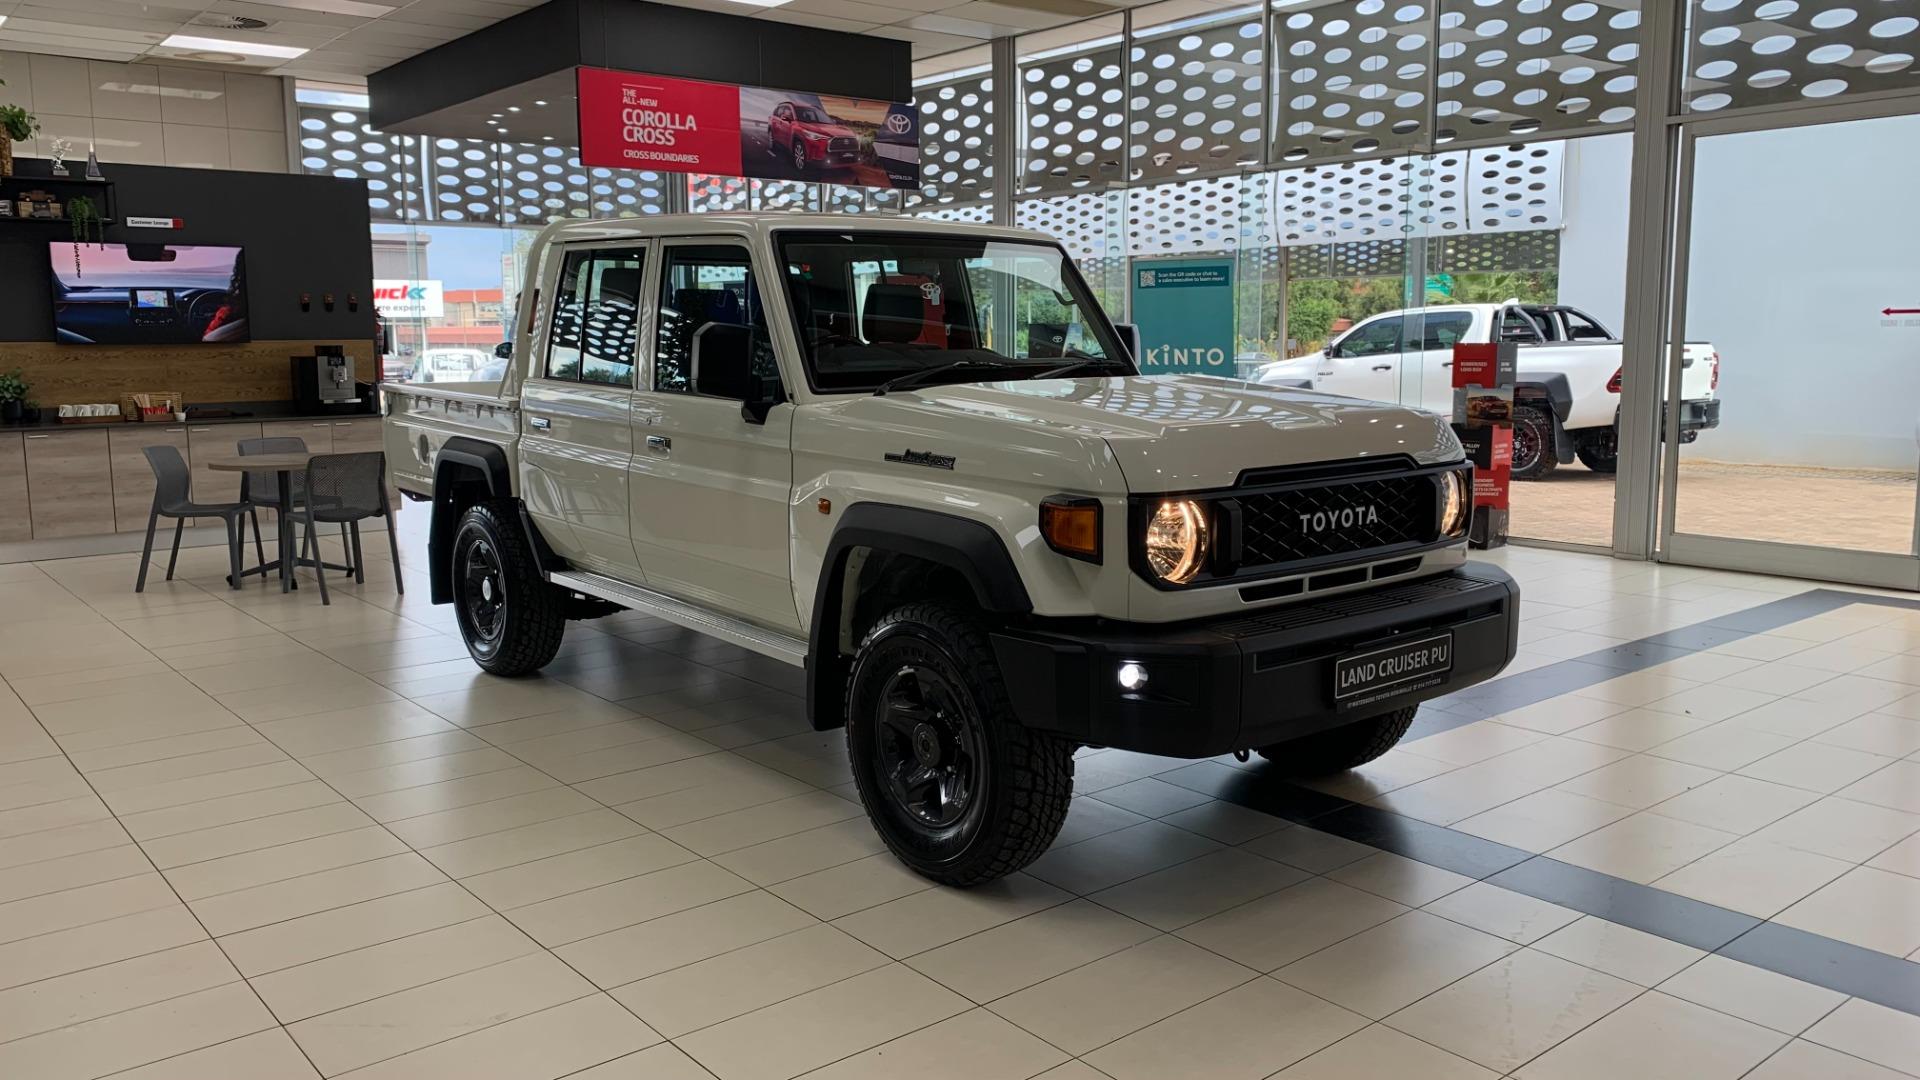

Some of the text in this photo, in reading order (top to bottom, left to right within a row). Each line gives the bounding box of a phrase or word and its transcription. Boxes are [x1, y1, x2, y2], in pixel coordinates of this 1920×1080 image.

[622, 88, 636, 97] THE
[622, 97, 658, 107] ALL-NEW
[622, 108, 697, 131] COROLLA
[623, 126, 675, 146] CROSS
[623, 149, 699, 163] CROSS BOUNDARIES
[1300, 505, 1378, 533] TOYOTA
[1341, 644, 1447, 688] LAND CRUISER PU
